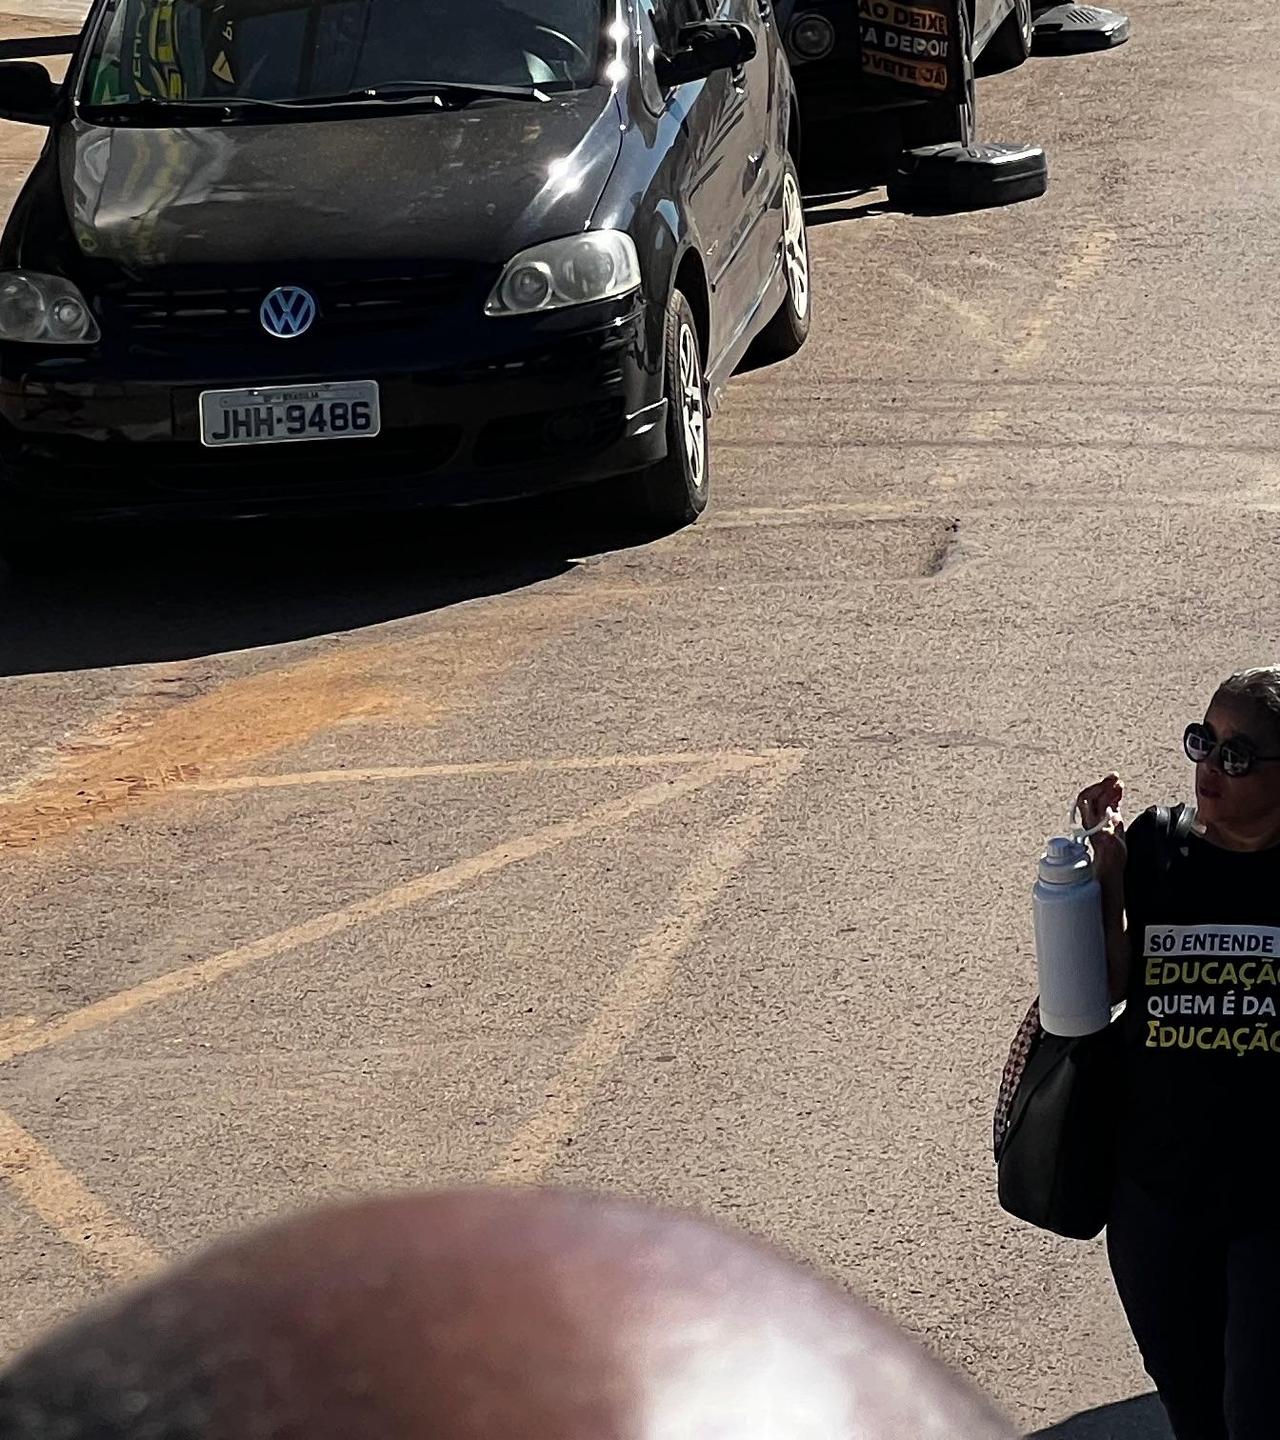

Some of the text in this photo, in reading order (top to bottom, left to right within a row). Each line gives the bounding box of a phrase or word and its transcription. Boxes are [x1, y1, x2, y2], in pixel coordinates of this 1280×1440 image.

[212, 401, 370, 440] JHH-9486
[1150, 929, 1175, 952] SÓ
[1181, 933, 1274, 953] ENTENDE
[1147, 990, 1276, 1018] QUEM É DA
